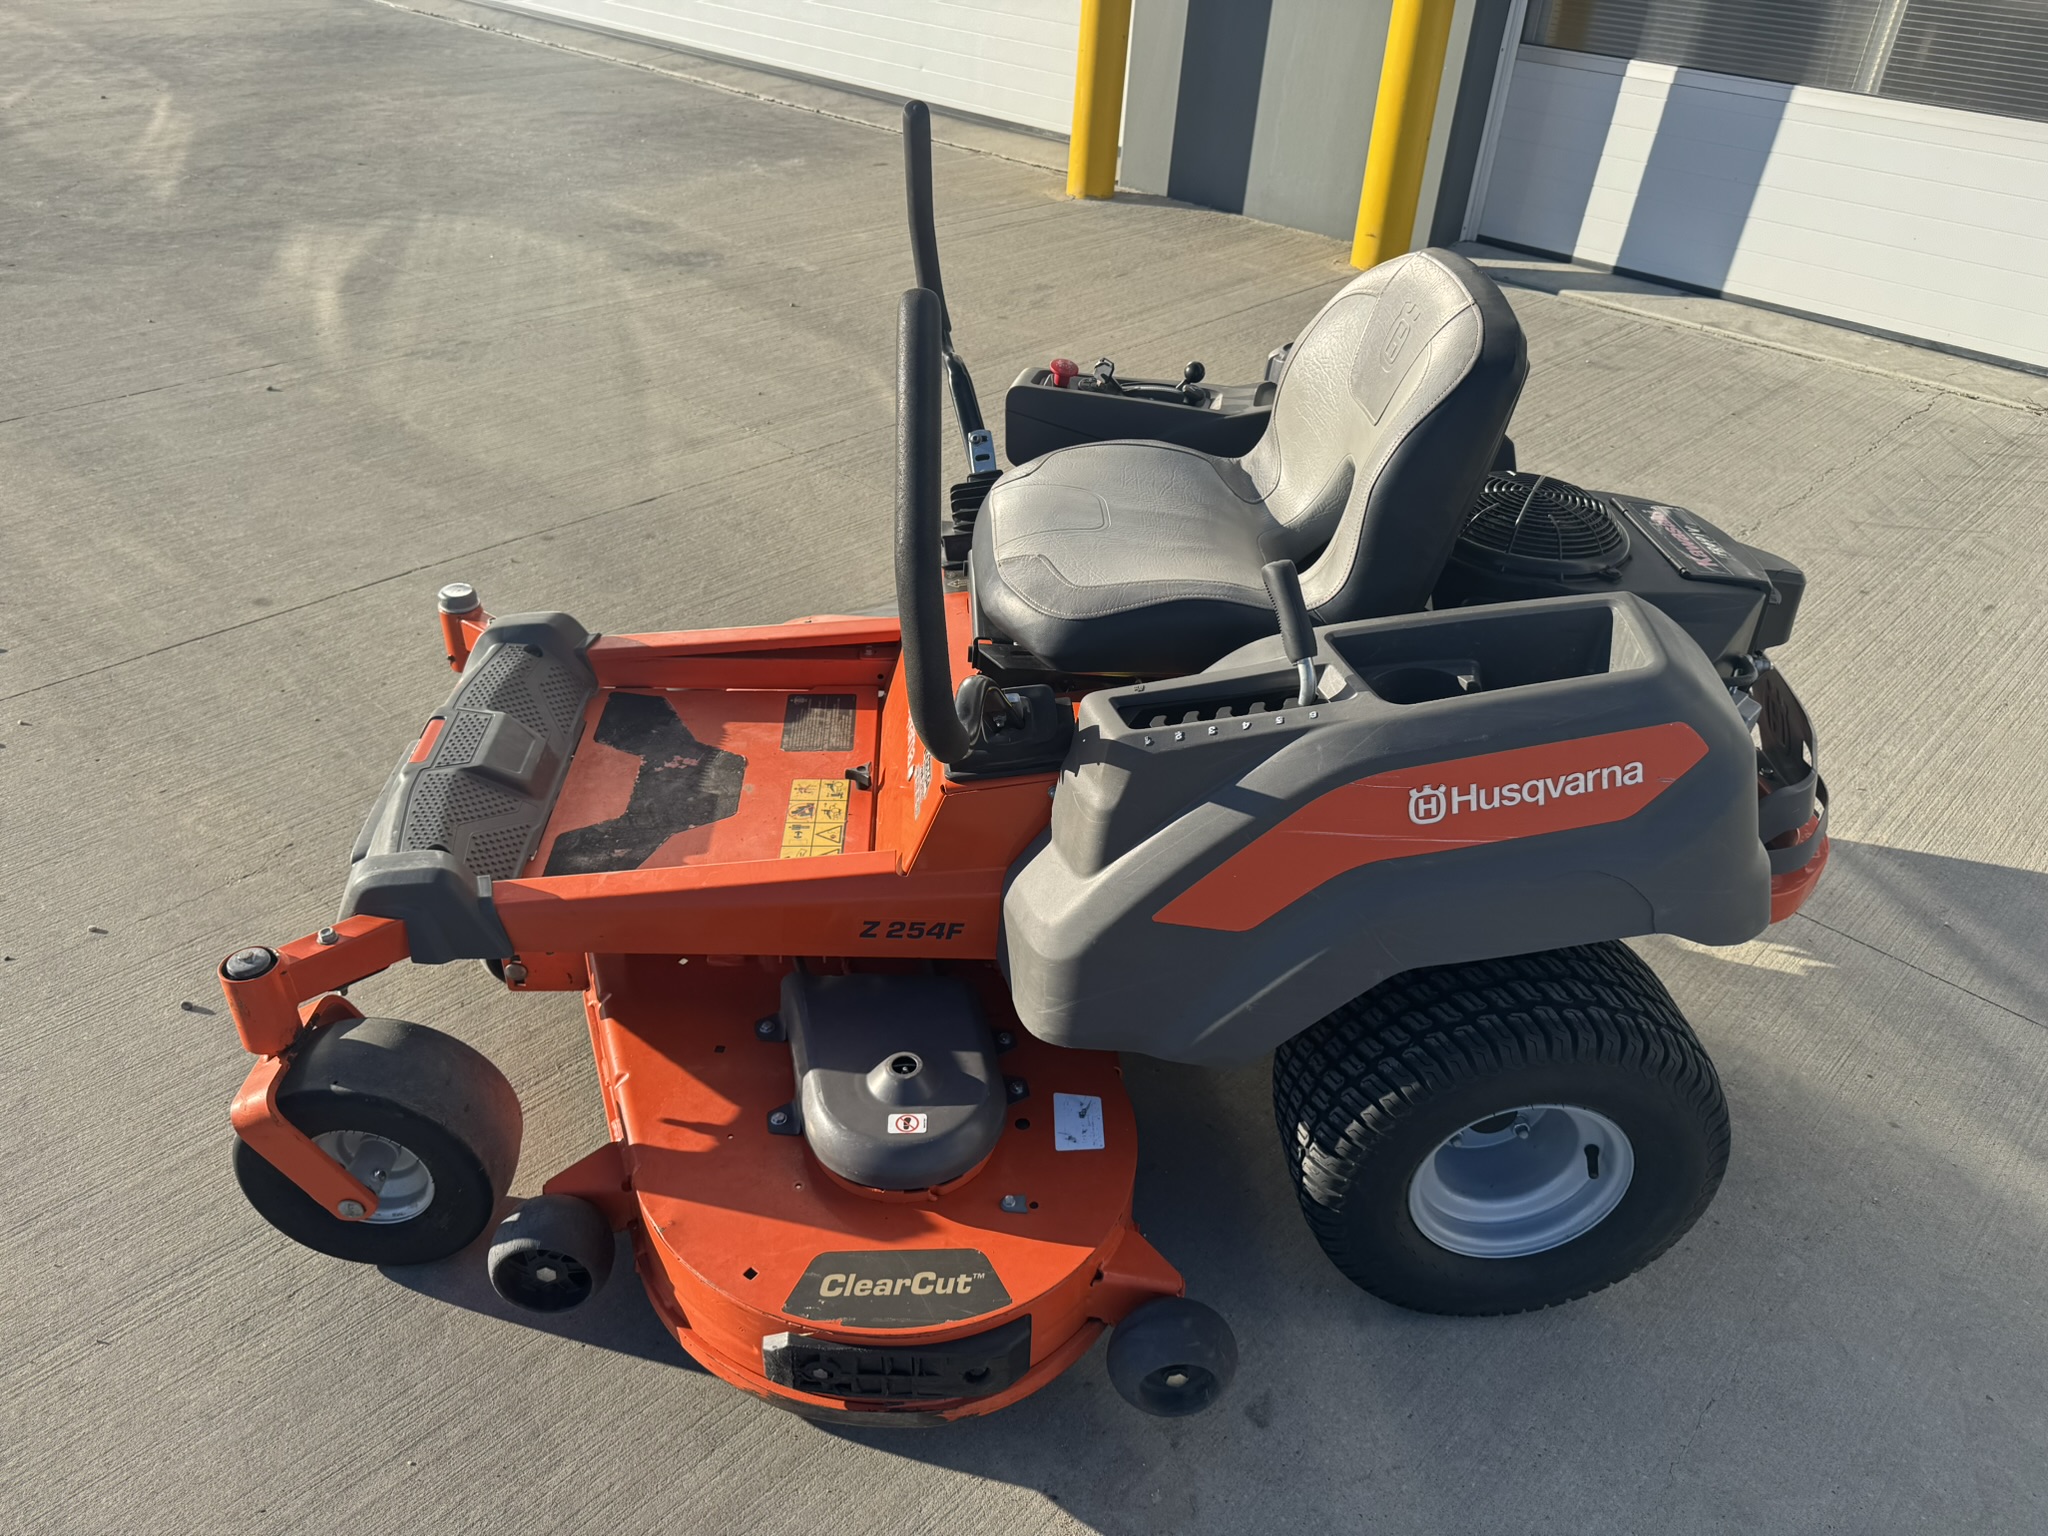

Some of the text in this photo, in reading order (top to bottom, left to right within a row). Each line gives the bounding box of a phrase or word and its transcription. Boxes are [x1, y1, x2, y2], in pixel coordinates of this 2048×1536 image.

[1451, 761, 1644, 815] Husqvarna
[859, 920, 965, 940] Z 254F
